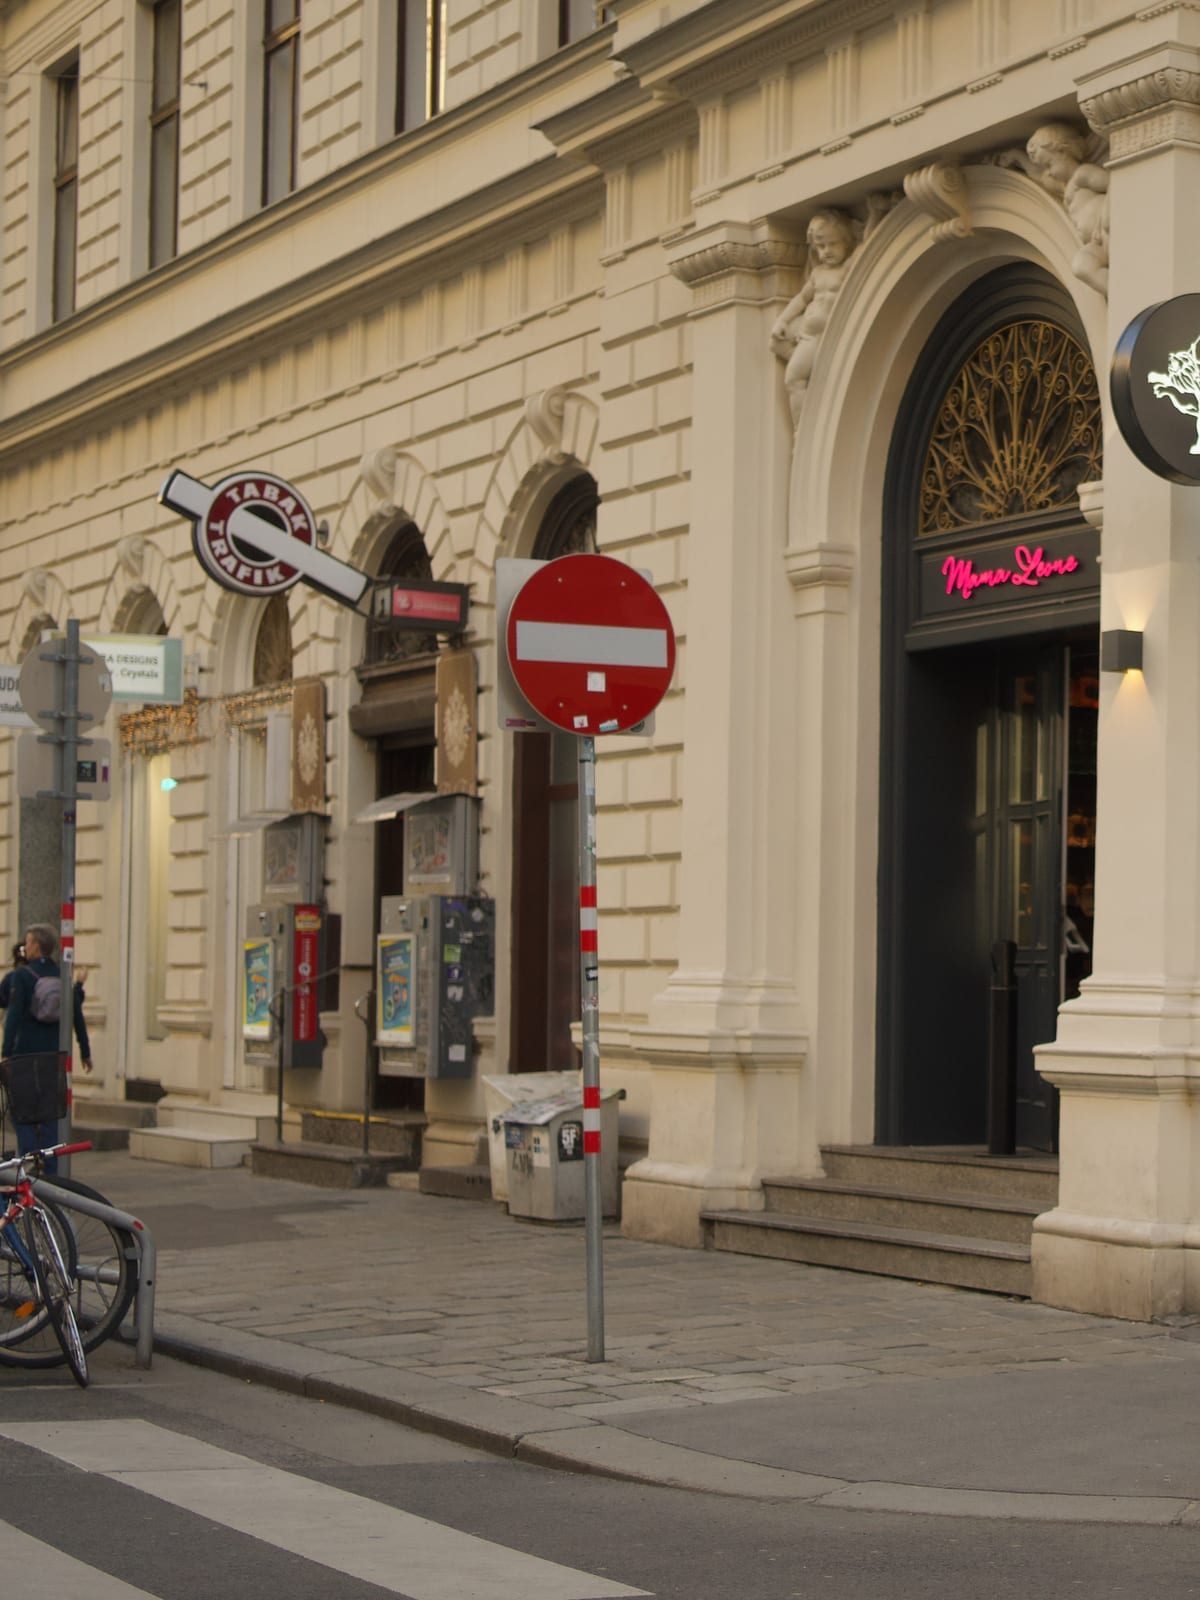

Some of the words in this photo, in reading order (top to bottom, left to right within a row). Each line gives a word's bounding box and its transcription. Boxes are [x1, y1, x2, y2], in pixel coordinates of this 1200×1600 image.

[225, 482, 308, 532] TABAK
[208, 520, 286, 586] TRAFIK
[942, 555, 1011, 599] Mama
[1011, 544, 1079, 586] Leone
[116, 654, 159, 664] DESIGNS
